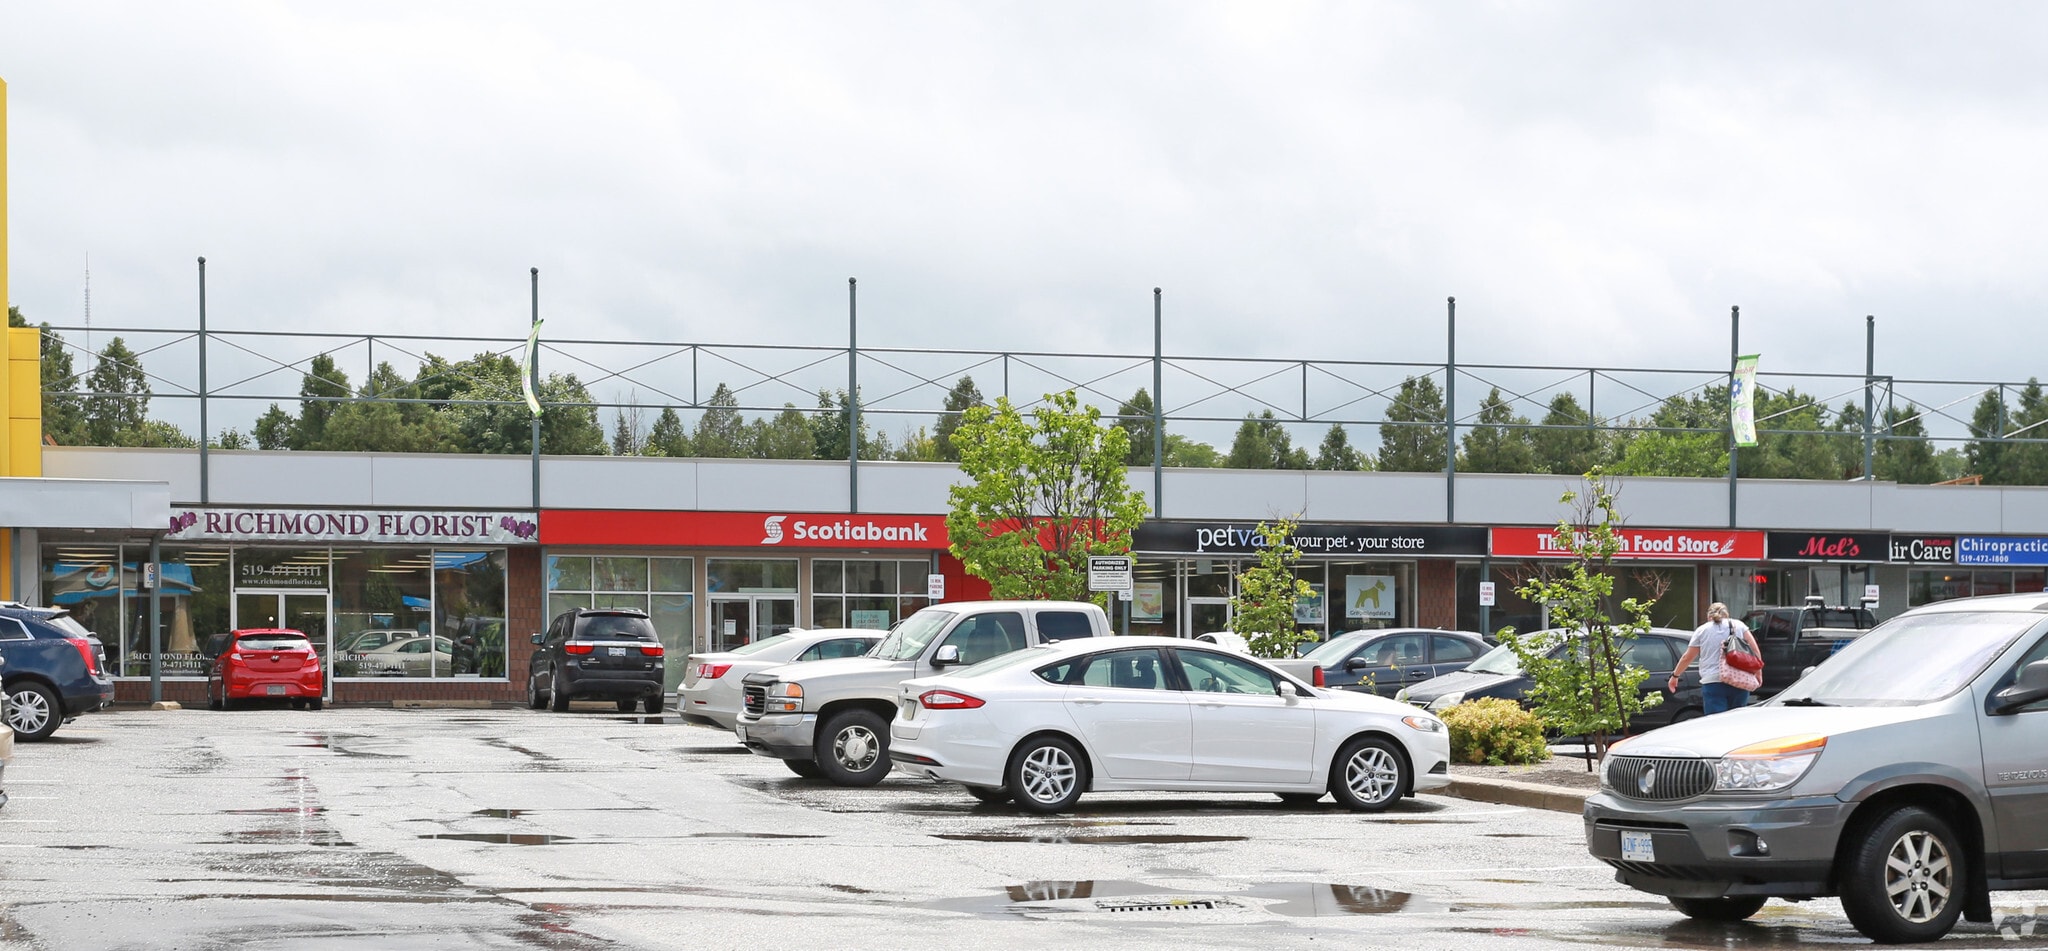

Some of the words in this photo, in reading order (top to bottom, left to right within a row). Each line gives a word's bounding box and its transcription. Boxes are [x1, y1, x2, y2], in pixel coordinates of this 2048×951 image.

[204, 512, 369, 535] RICHMOND
[378, 514, 493, 537] FLORIST
[793, 520, 928, 541] Scotiabank
[1196, 525, 1285, 552] petva
[1292, 536, 1323, 551] your
[1326, 535, 1347, 551] pet
[1357, 537, 1388, 552] your
[1391, 537, 1425, 549] store
[1634, 535, 1673, 552] Food
[1677, 538, 1719, 553] Store
[1798, 537, 1860, 557] Mel's
[1961, 538, 2048, 555] Chiropractic
[1910, 539, 1952, 560] Care
[1960, 555, 2009, 563] 519-472-1800
[241, 565, 322, 577] 519-471-1111
